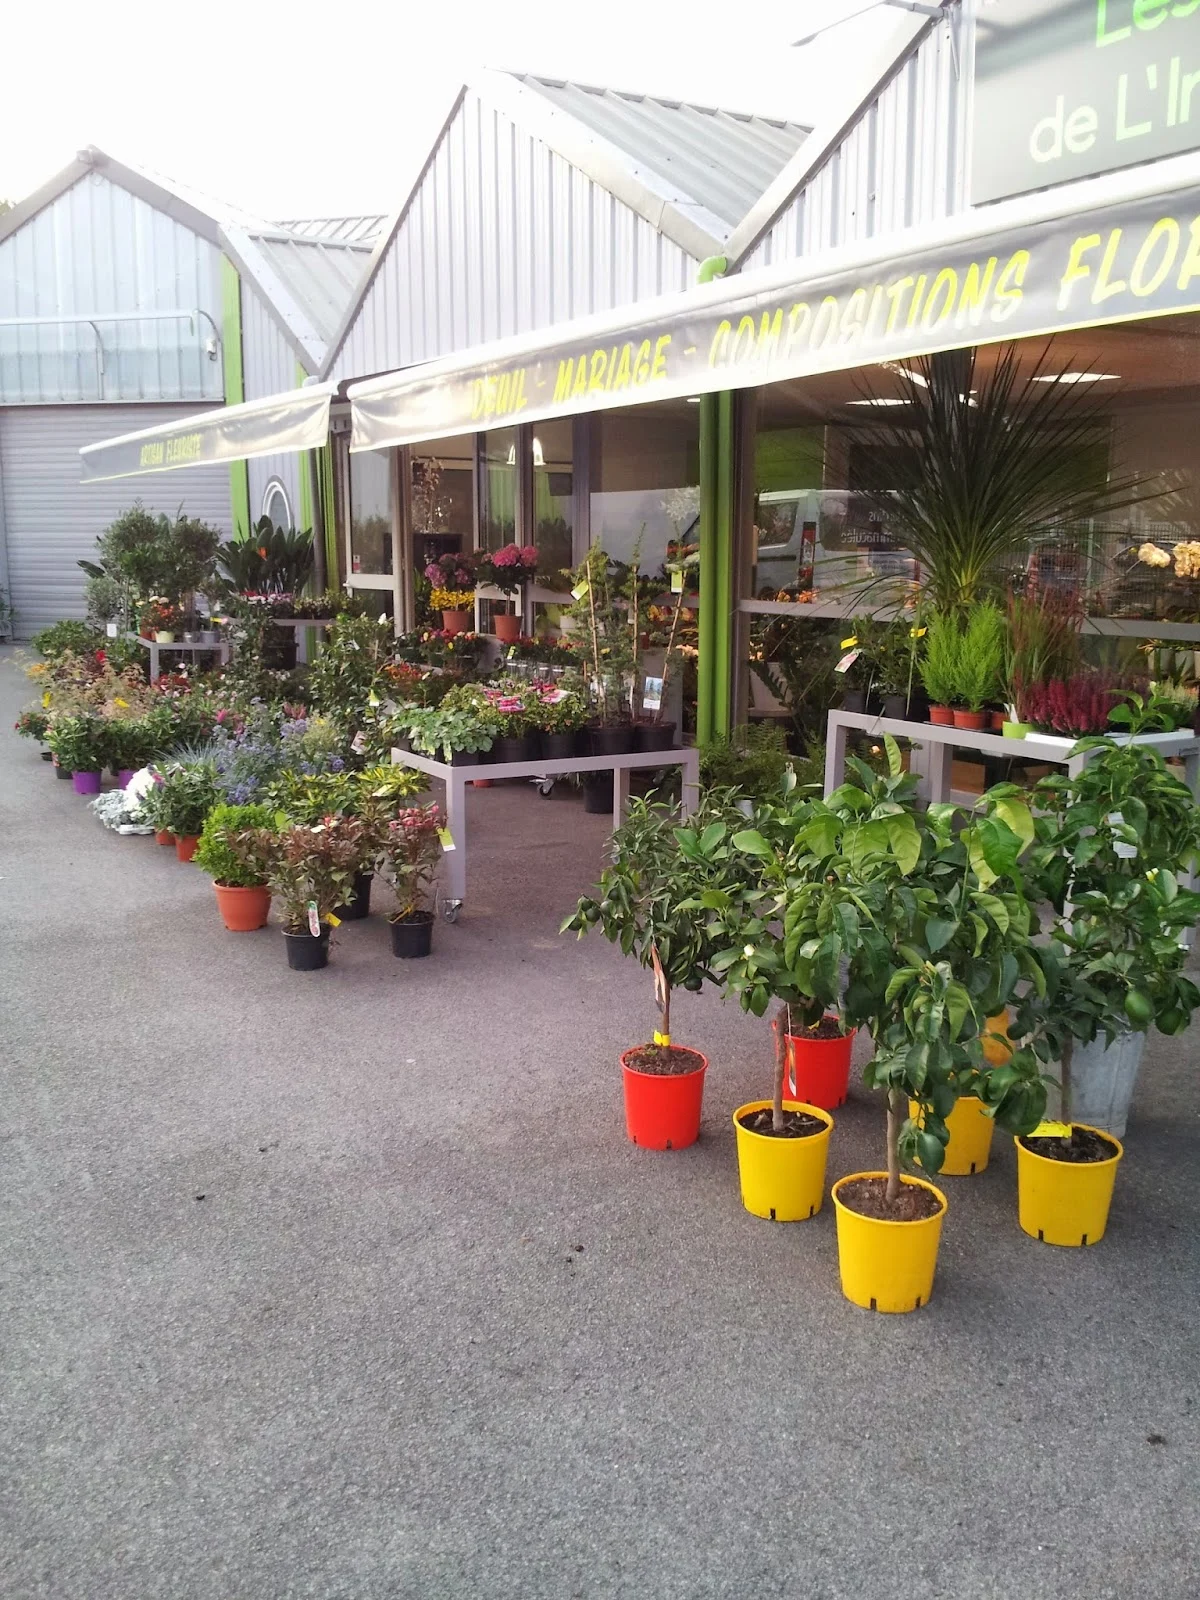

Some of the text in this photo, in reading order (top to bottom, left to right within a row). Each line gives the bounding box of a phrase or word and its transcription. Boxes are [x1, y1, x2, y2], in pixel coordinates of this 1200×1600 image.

[1029, 95, 1098, 163] de
[471, 368, 527, 420] DEUIL
[552, 334, 672, 404] MARIAGE
[708, 249, 1031, 372] COMPOSITIONS
